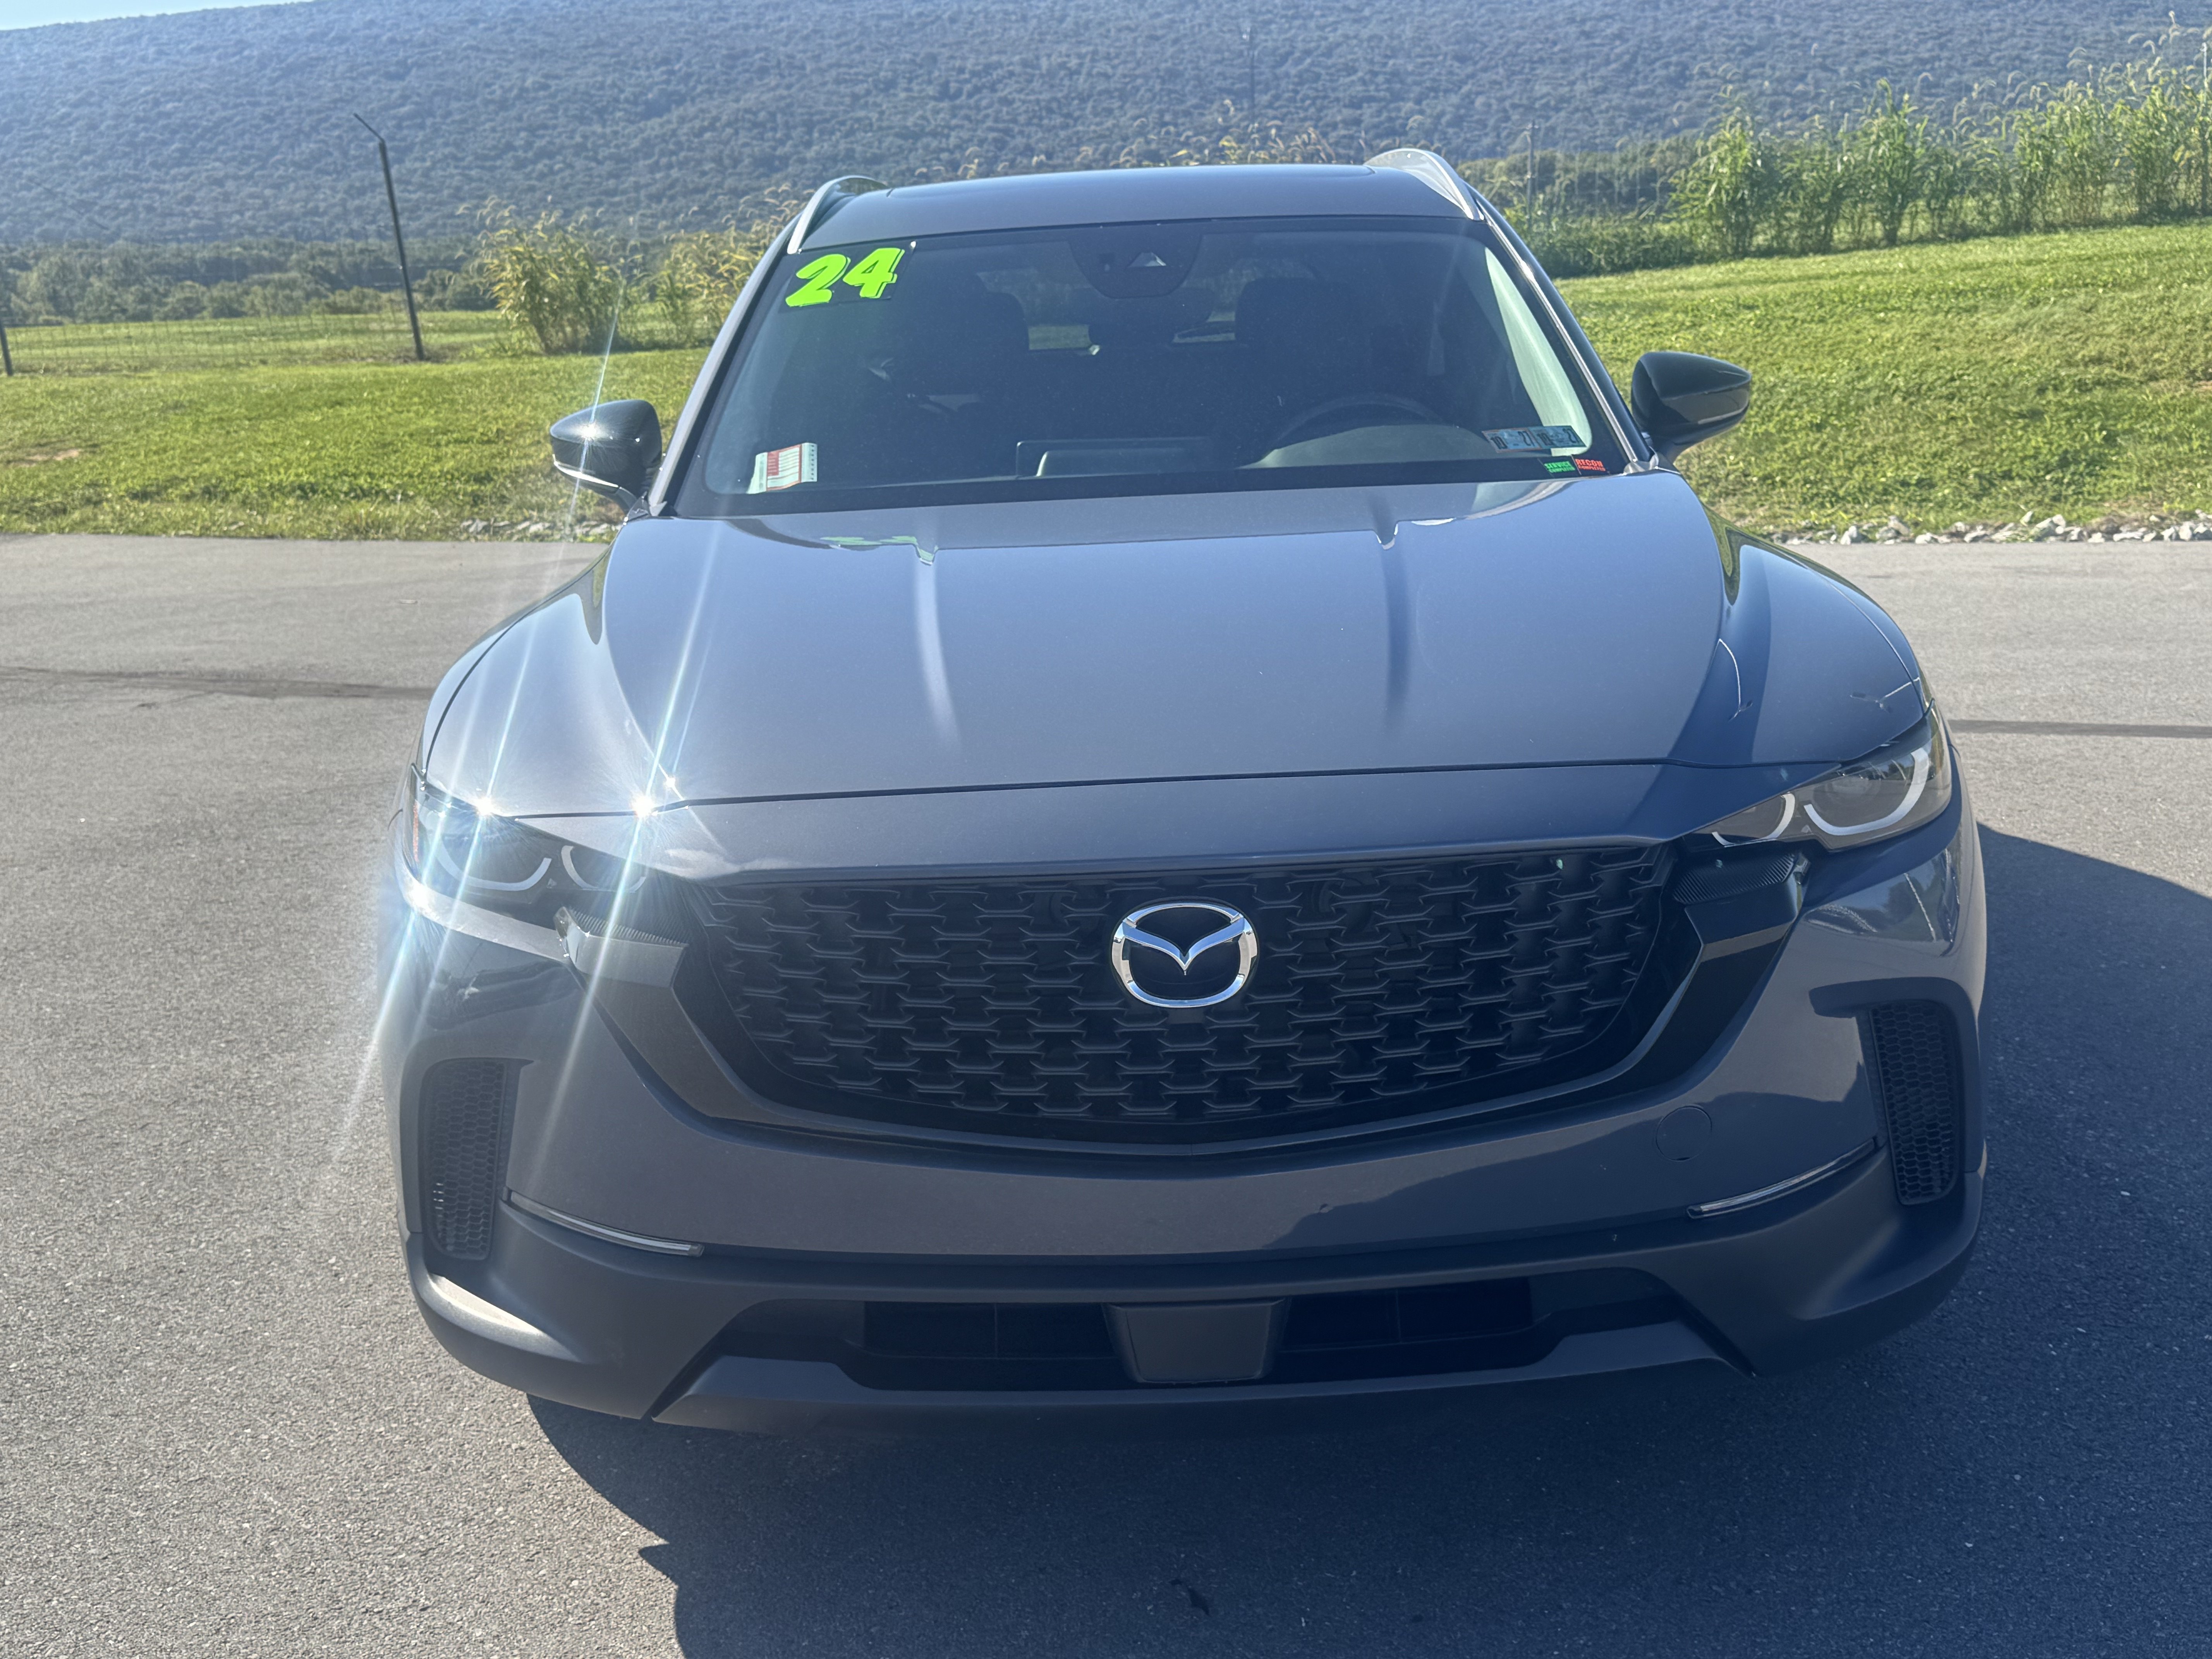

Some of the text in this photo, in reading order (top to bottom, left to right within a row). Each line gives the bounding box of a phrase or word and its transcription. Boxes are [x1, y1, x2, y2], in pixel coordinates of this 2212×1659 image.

[786, 247, 905, 307] 24
[1490, 436, 1508, 449] 10
[1575, 459, 1604, 467] RECON
